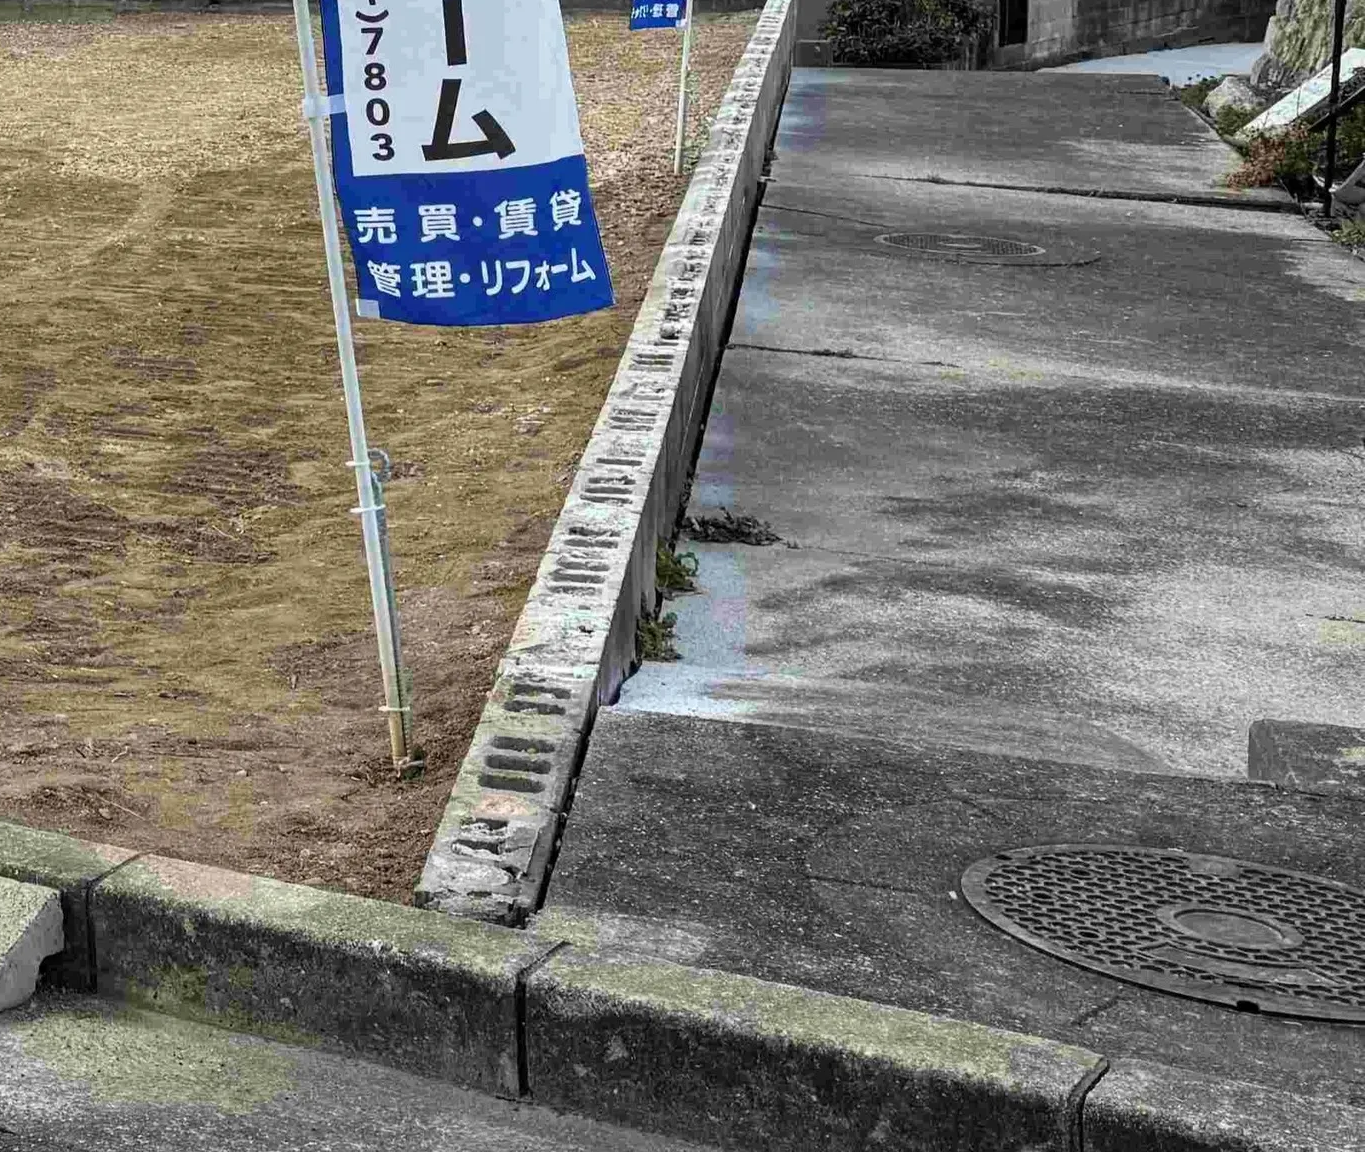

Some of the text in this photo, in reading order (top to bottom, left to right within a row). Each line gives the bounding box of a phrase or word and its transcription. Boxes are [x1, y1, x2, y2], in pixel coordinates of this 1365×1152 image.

[354, 189, 582, 244] 売買・賃貸
[367, 247, 596, 298] 管理・リフォーム
